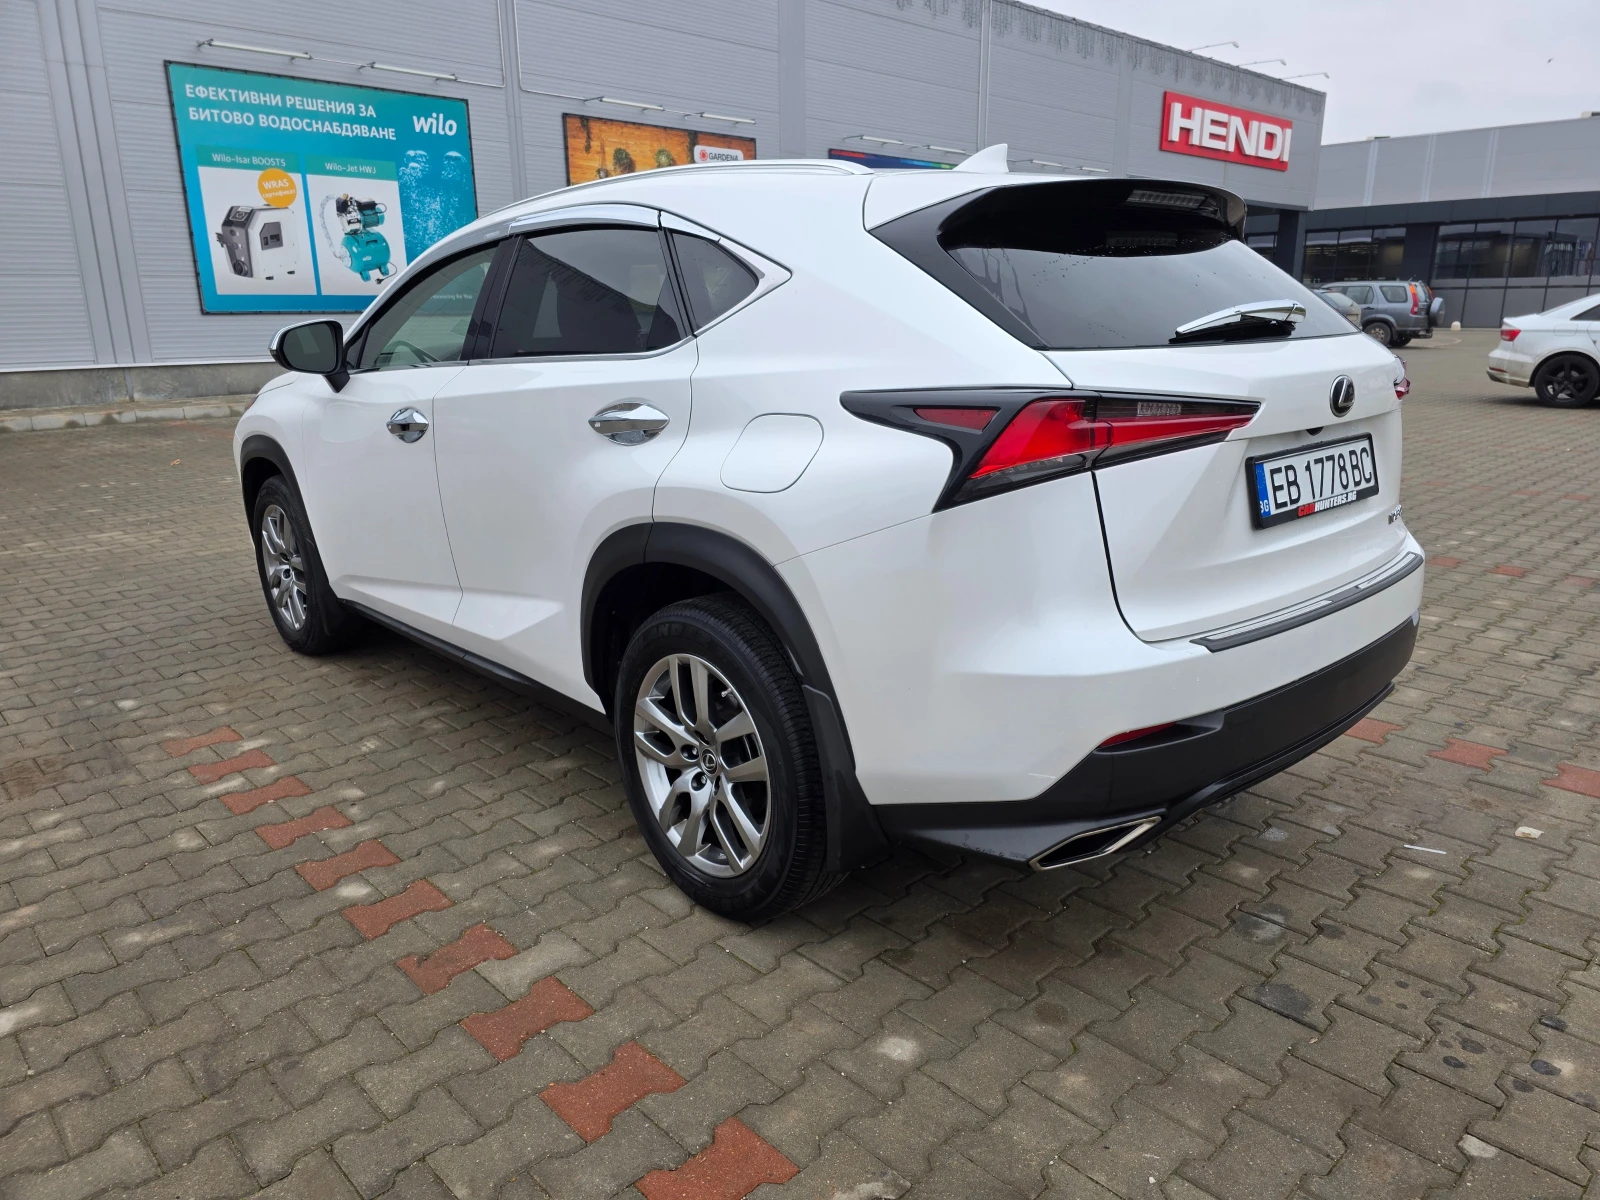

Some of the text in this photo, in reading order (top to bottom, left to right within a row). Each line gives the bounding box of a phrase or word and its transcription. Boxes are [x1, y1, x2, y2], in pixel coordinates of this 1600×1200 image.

[185, 84, 377, 118] ЕФЕКТИВНИ РЕШЕНИЯ ЗА
[188, 107, 397, 140] БИТОВО ВОДОСНАБДЯВАНЕ
[412, 112, 457, 136] wilo
[1168, 102, 1292, 162] HENDI
[212, 152, 250, 164] Wilo-Isar
[324, 162, 358, 173] Wilo-Jet
[708, 152, 739, 161] GARDENA
[262, 179, 289, 190] WRAS
[1270, 447, 1372, 510] EB 1778 BC
